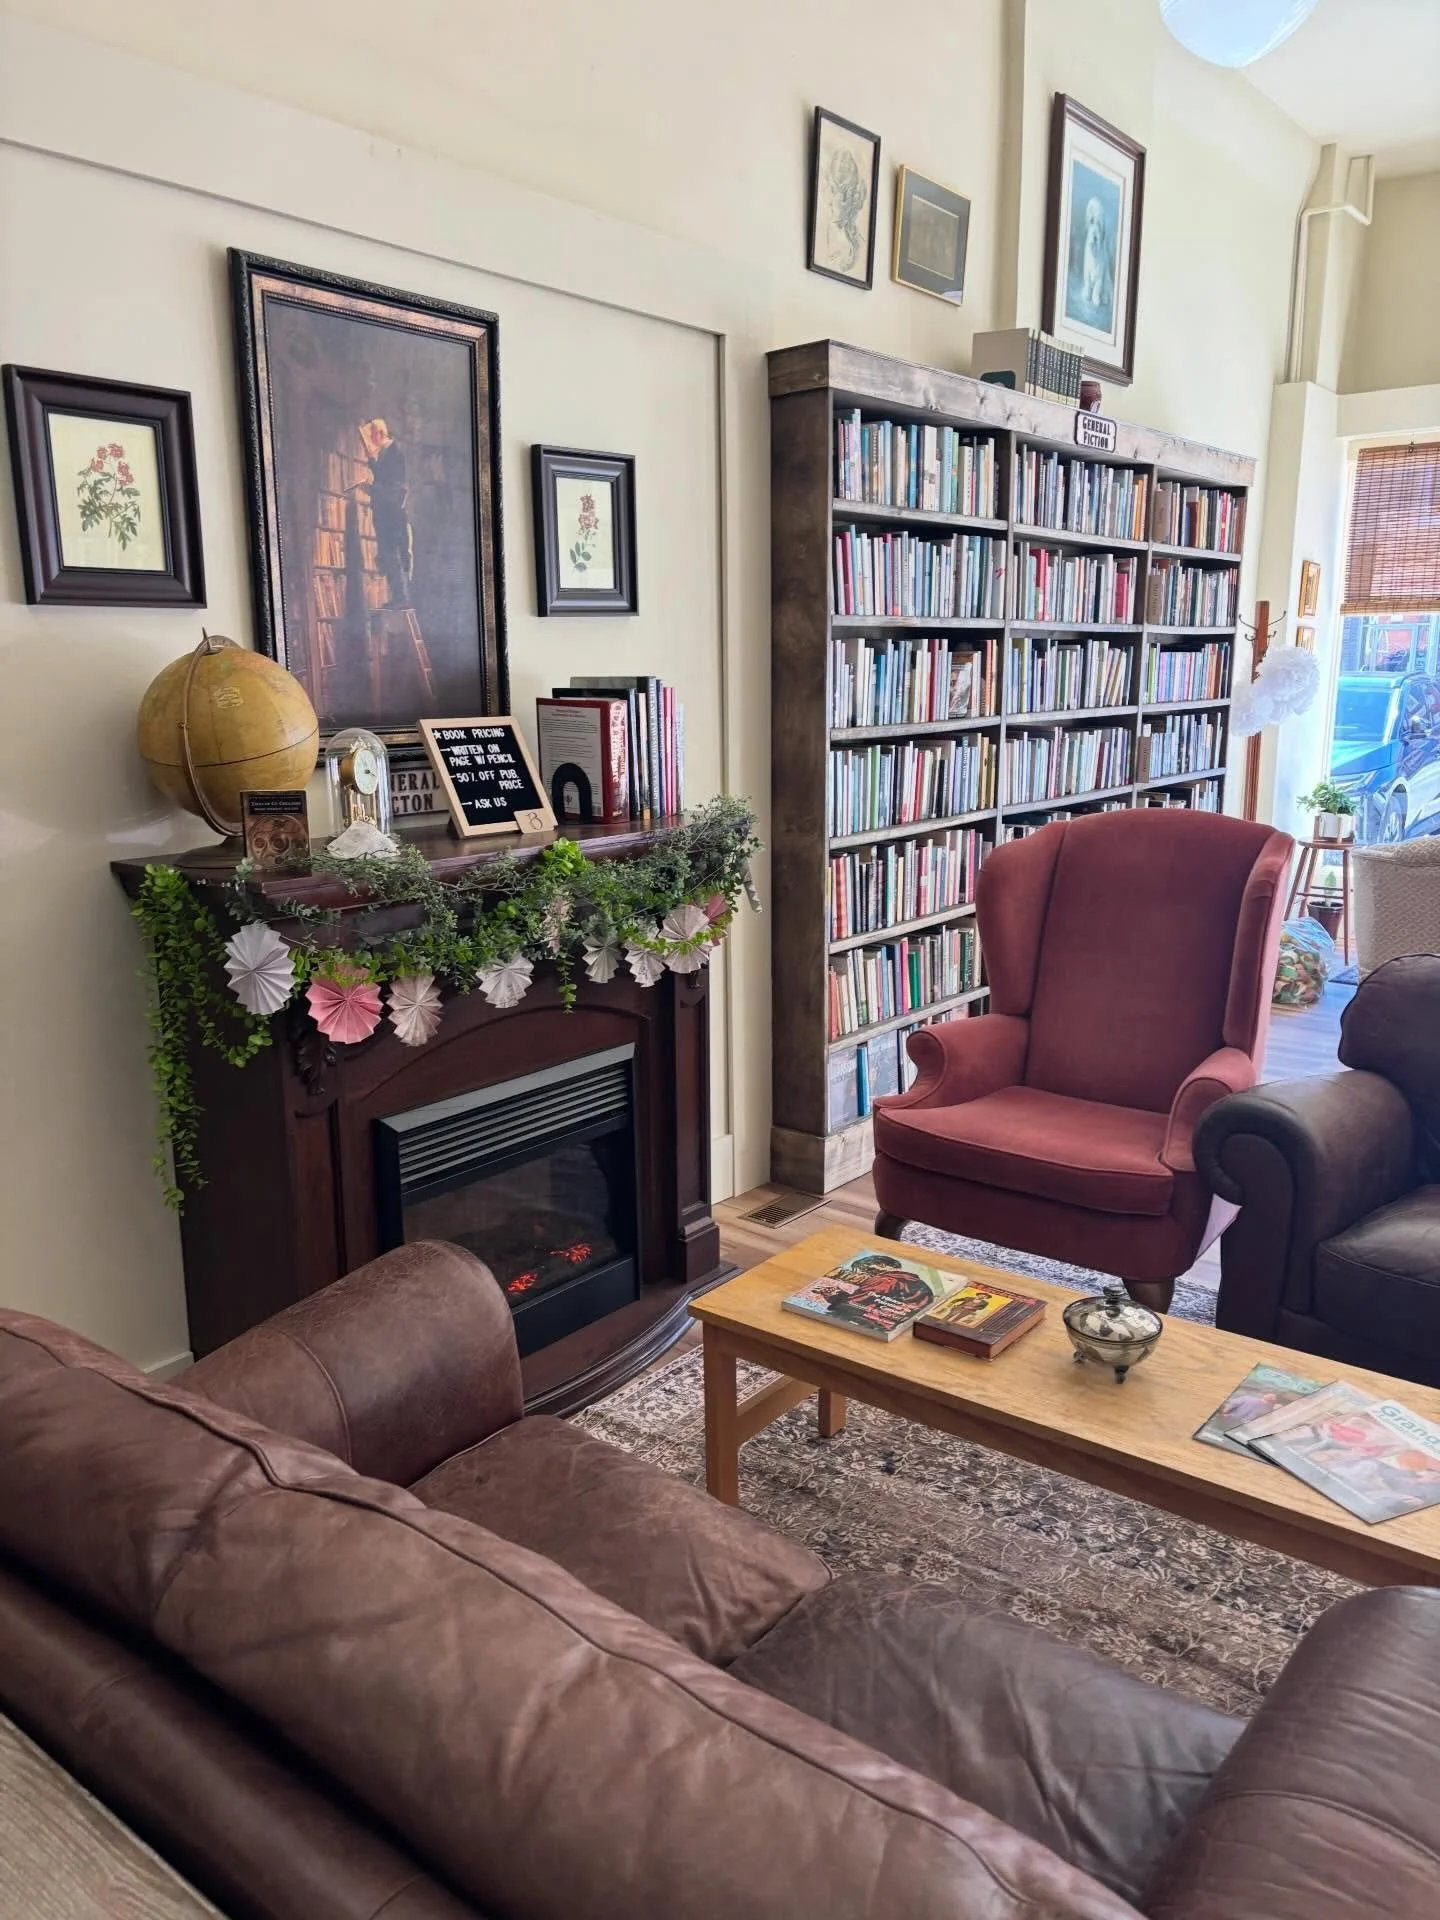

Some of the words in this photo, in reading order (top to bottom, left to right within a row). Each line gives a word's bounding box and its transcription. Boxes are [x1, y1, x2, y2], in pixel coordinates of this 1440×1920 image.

[1083, 416, 1111, 436] GENERAL
[1083, 430, 1109, 449] FICTION
[442, 729, 467, 740] BOOK
[472, 728, 505, 739] PRICING
[450, 744, 484, 756] WRITTEN
[487, 743, 501, 753] ON
[449, 755, 472, 767] PAGE
[474, 755, 486, 765] W/
[486, 753, 516, 764] PENCIL
[391, 772, 440, 791] ERAL
[478, 770, 495, 781] OFF
[499, 769, 520, 779] PUB.
[498, 779, 524, 790] PRICE
[474, 798, 493, 809] ASK
[493, 796, 508, 807] US
